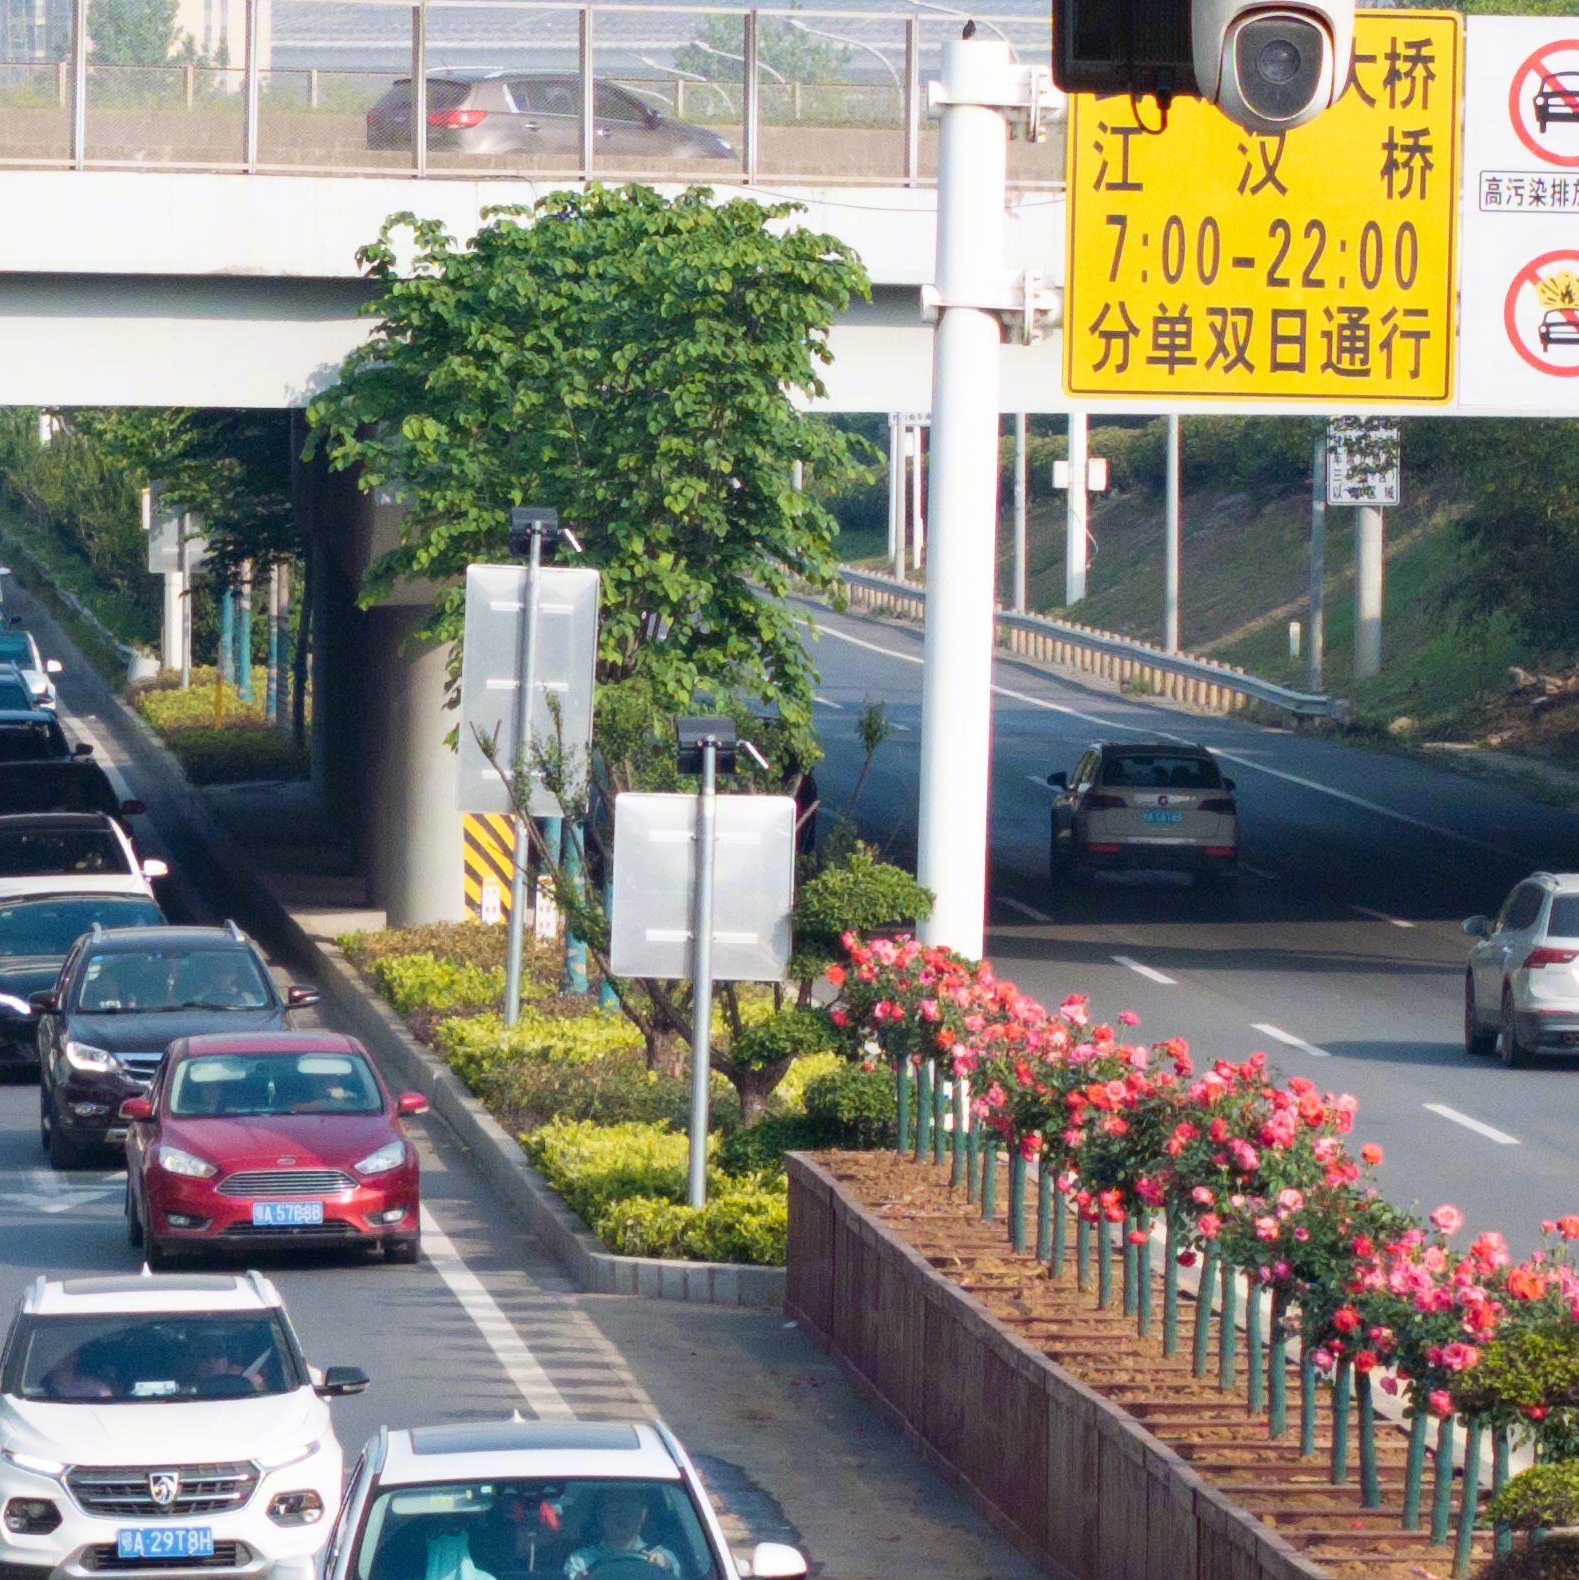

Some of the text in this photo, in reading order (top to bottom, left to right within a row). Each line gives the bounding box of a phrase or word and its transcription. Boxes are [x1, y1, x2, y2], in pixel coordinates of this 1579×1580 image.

[1104, 214, 1420, 291] 7:00-22:00
[1088, 301, 1432, 382] 分单双日通行
